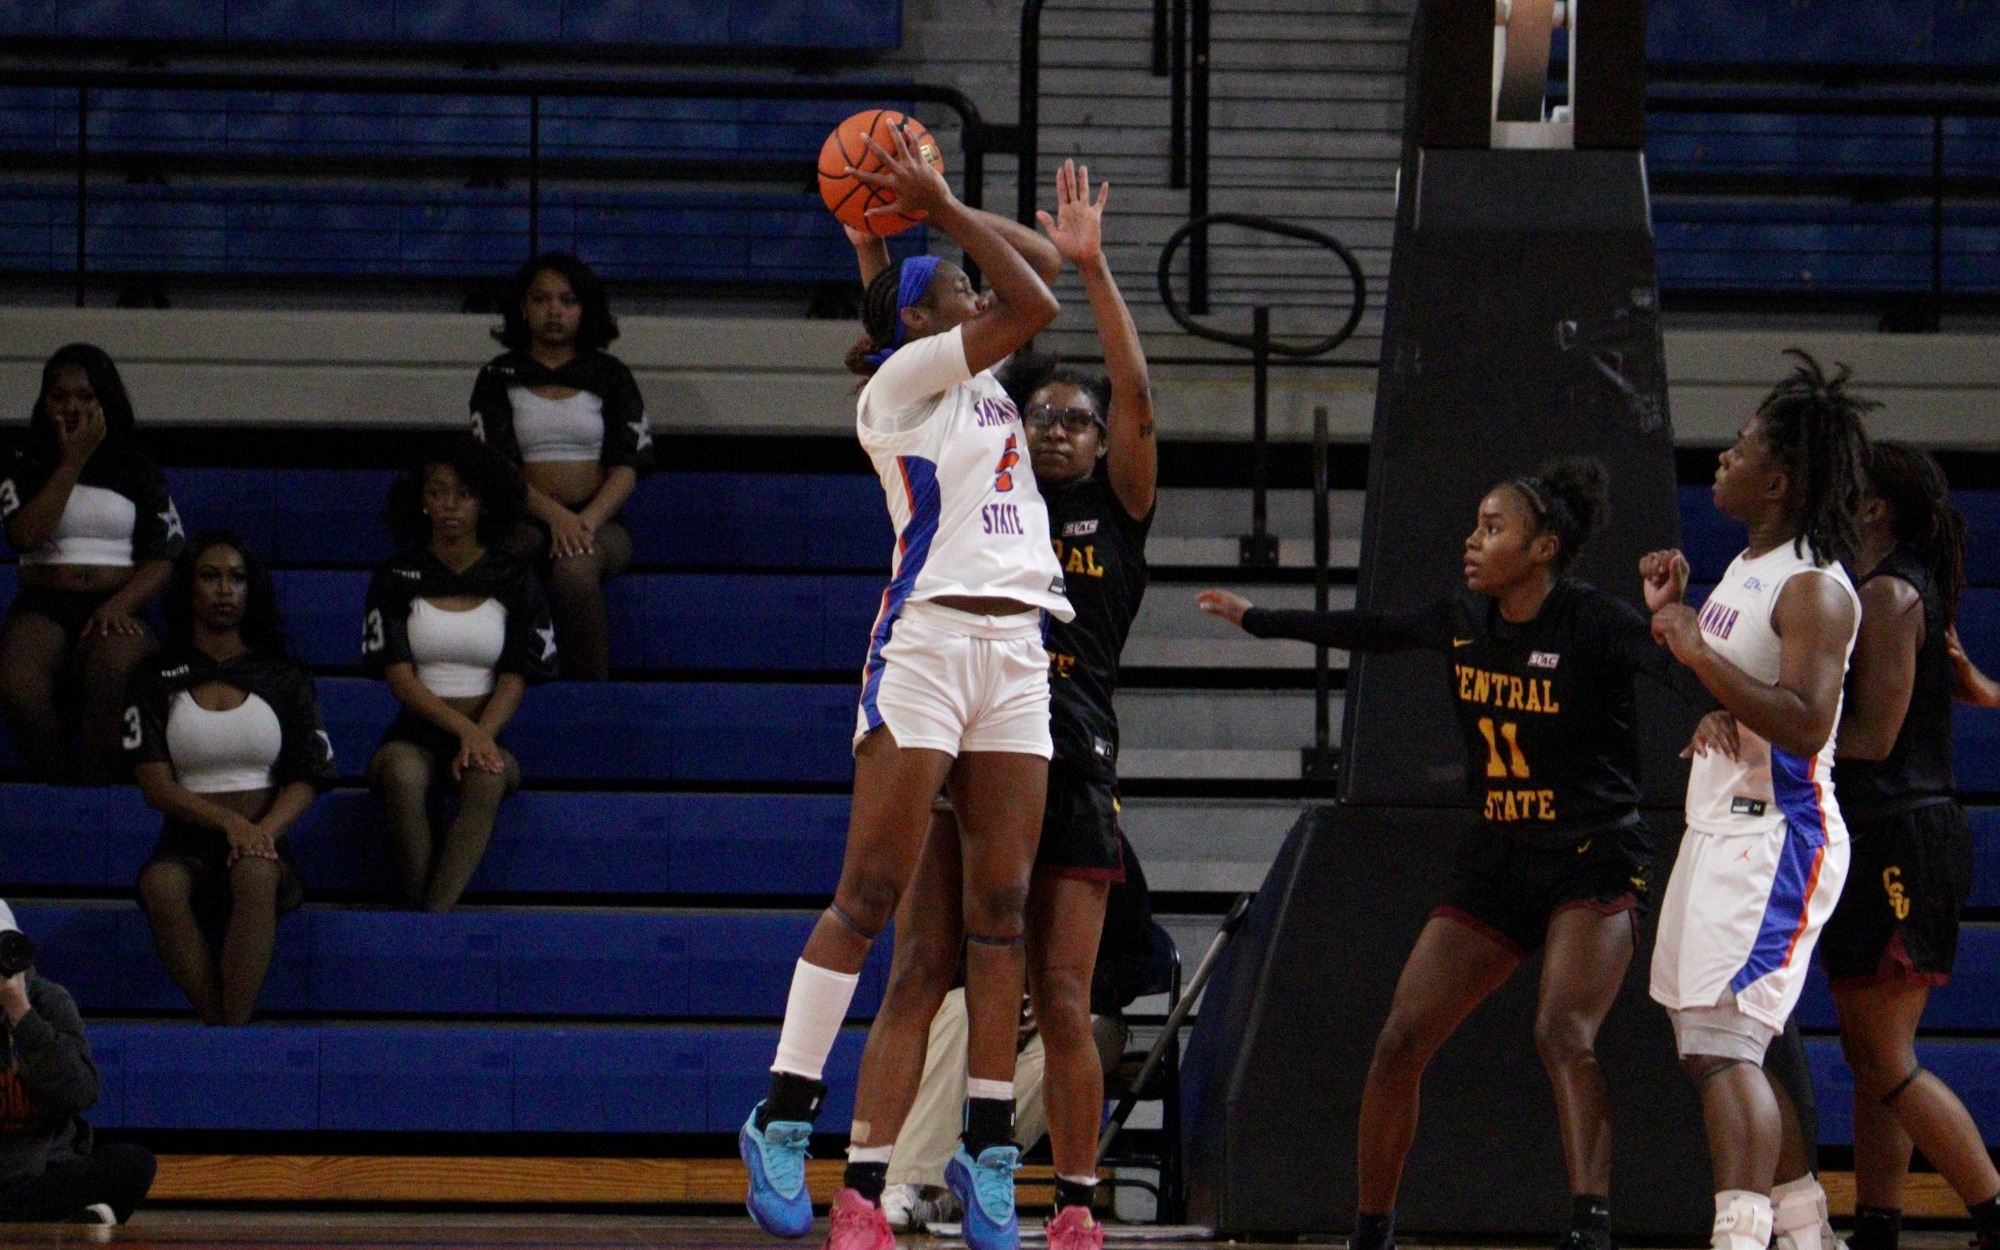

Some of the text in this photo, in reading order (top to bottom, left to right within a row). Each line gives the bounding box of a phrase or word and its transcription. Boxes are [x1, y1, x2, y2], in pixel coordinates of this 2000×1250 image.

[982, 503, 1024, 535] STATE
[122, 705, 143, 750] 3
[1478, 717, 1530, 778] 11
[1484, 790, 1556, 821] STATE
